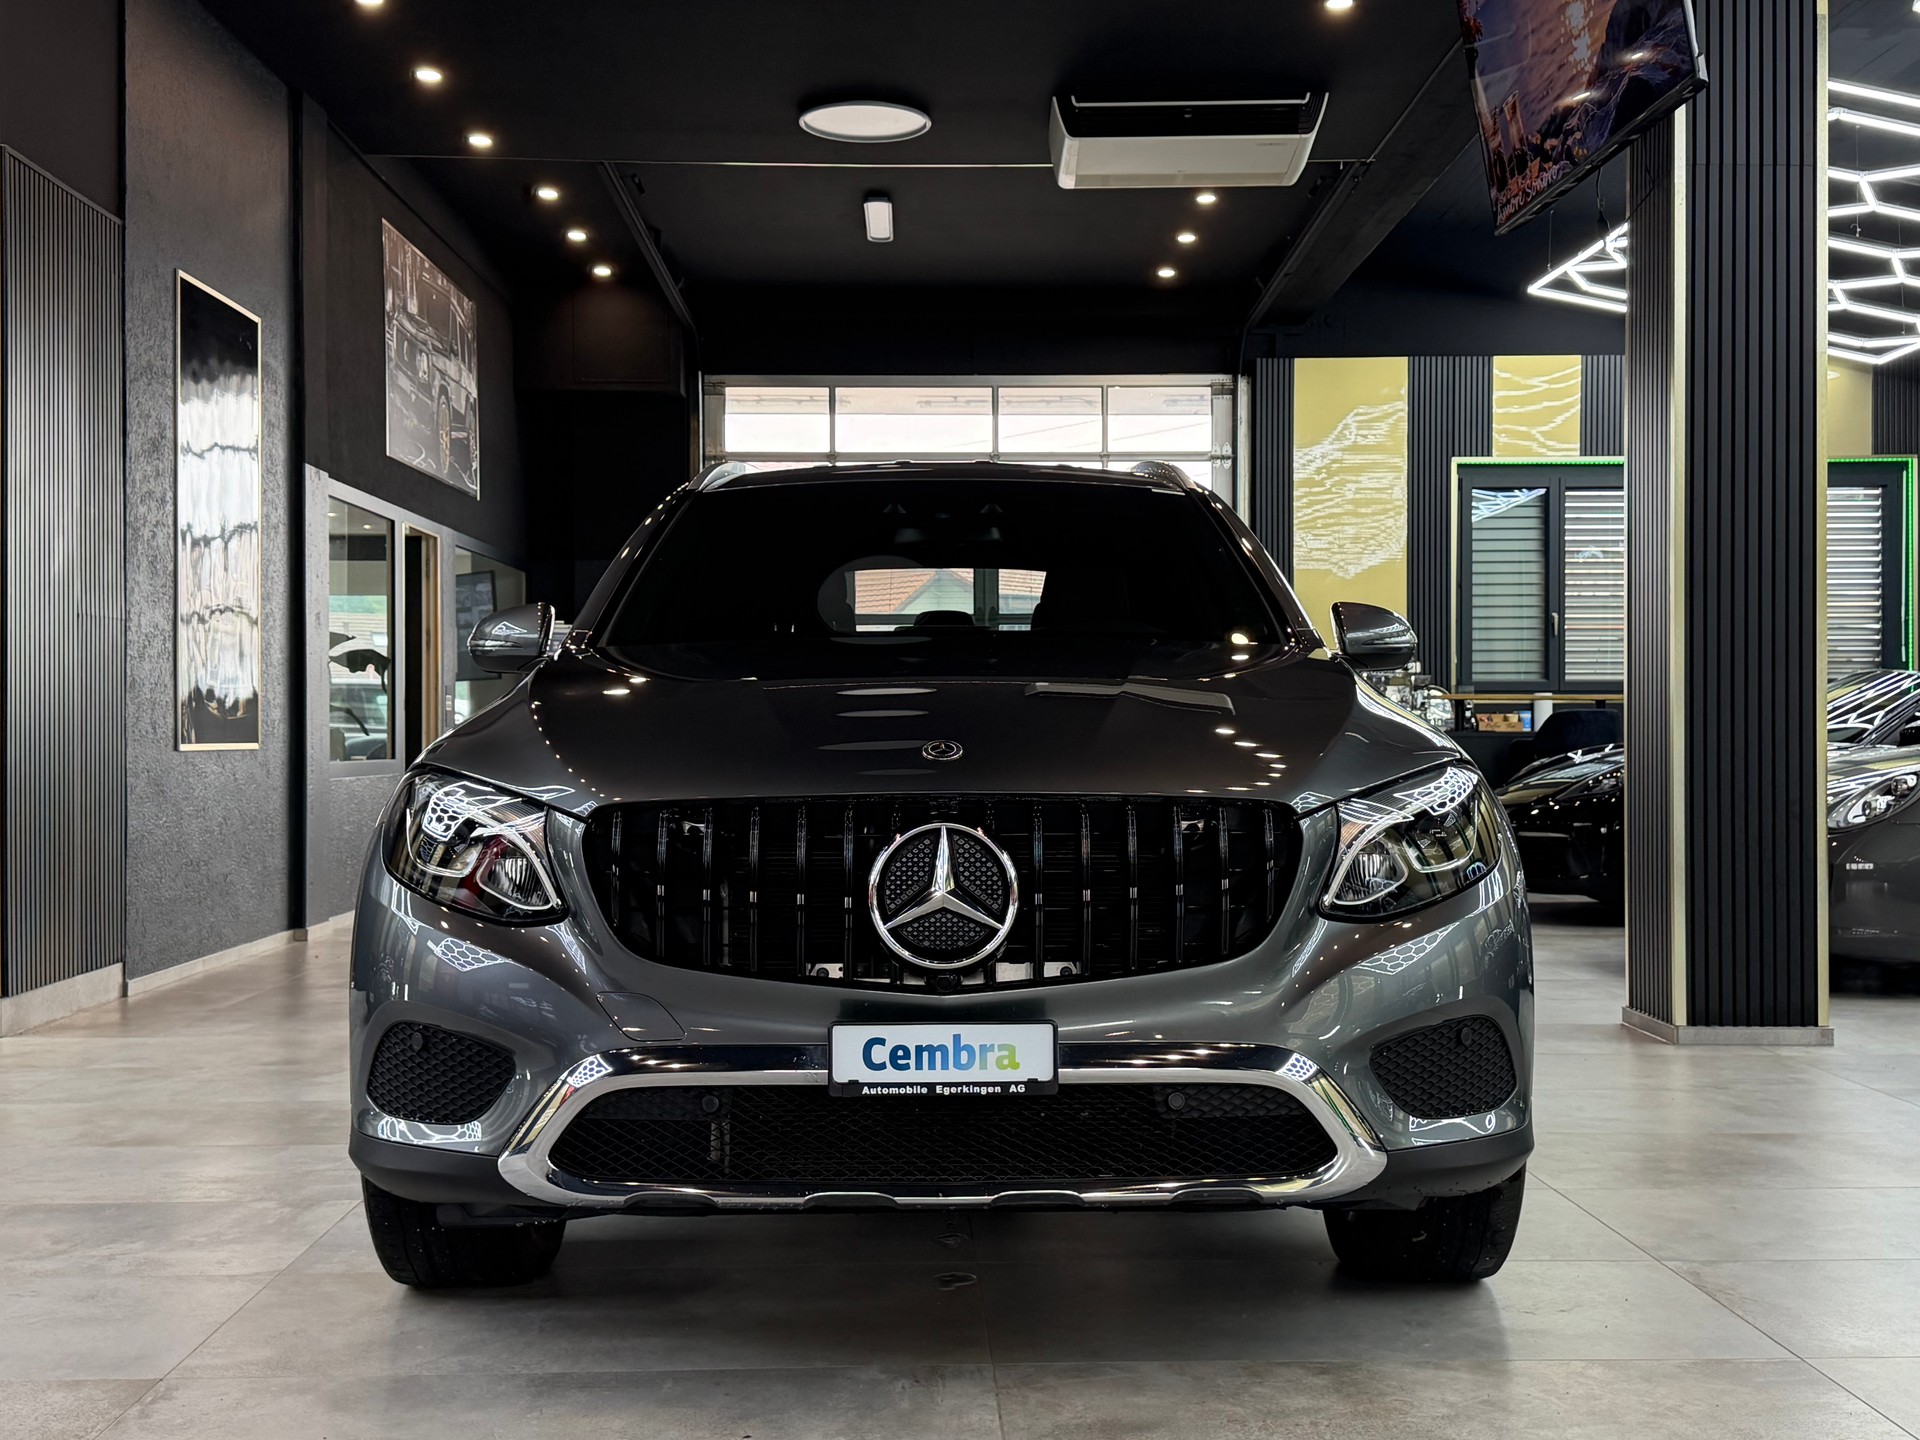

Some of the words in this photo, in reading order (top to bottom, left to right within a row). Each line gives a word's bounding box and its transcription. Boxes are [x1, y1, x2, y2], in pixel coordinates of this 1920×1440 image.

[862, 1033, 1020, 1071] Cembra
[861, 1085, 928, 1095] Automobile
[935, 1084, 1001, 1095] Egerkingen
[1009, 1084, 1026, 1093] AG
